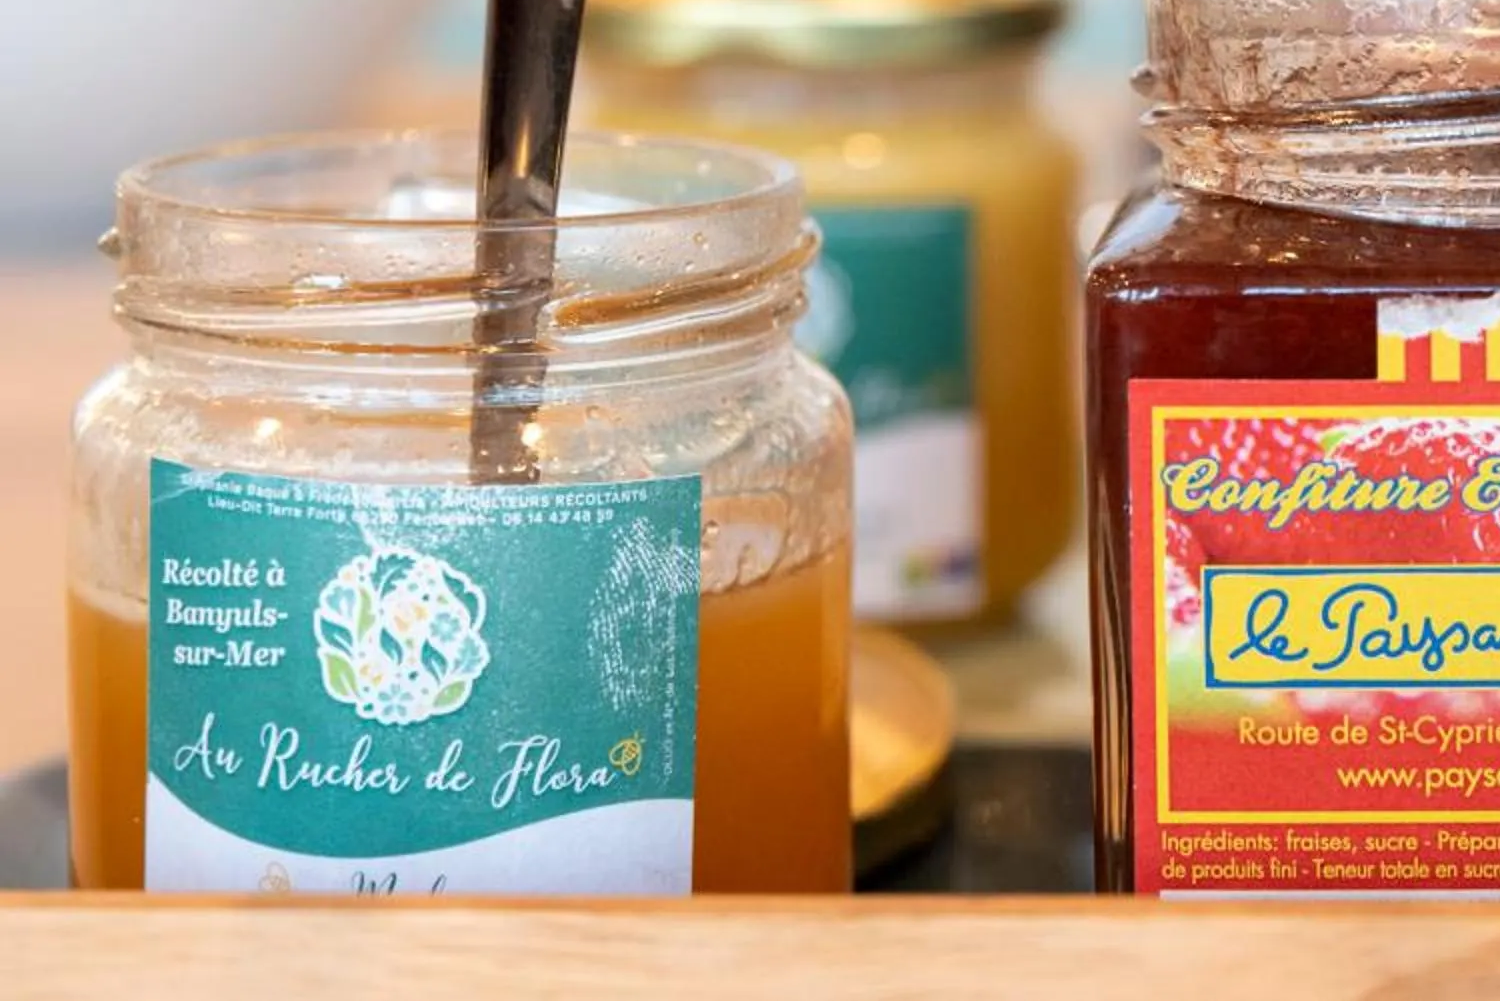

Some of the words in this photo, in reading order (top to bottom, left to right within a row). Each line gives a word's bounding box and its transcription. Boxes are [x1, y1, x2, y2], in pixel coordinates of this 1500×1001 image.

[1162, 458, 1452, 530] Confiture
[162, 557, 260, 587] Récolté
[265, 558, 287, 587] à
[165, 598, 289, 634] Banyuls-
[1229, 588, 1309, 662] le
[173, 640, 287, 667] sur-Mer
[1239, 715, 1319, 745] Route
[1331, 714, 1368, 745] de
[174, 712, 243, 780] Au
[256, 722, 410, 794] Rucher
[424, 739, 475, 792] de
[491, 734, 617, 808] Flora
[1161, 830, 1279, 856] Ingrédients:
[1287, 829, 1357, 854] fraises,
[1365, 834, 1418, 851] sucre
[1162, 859, 1187, 879] de
[1192, 858, 1265, 884] produits
[1270, 858, 1297, 879] fini
[1312, 858, 1374, 880] Teneur
[1380, 859, 1430, 879] totale
[1435, 864, 1458, 879] en
